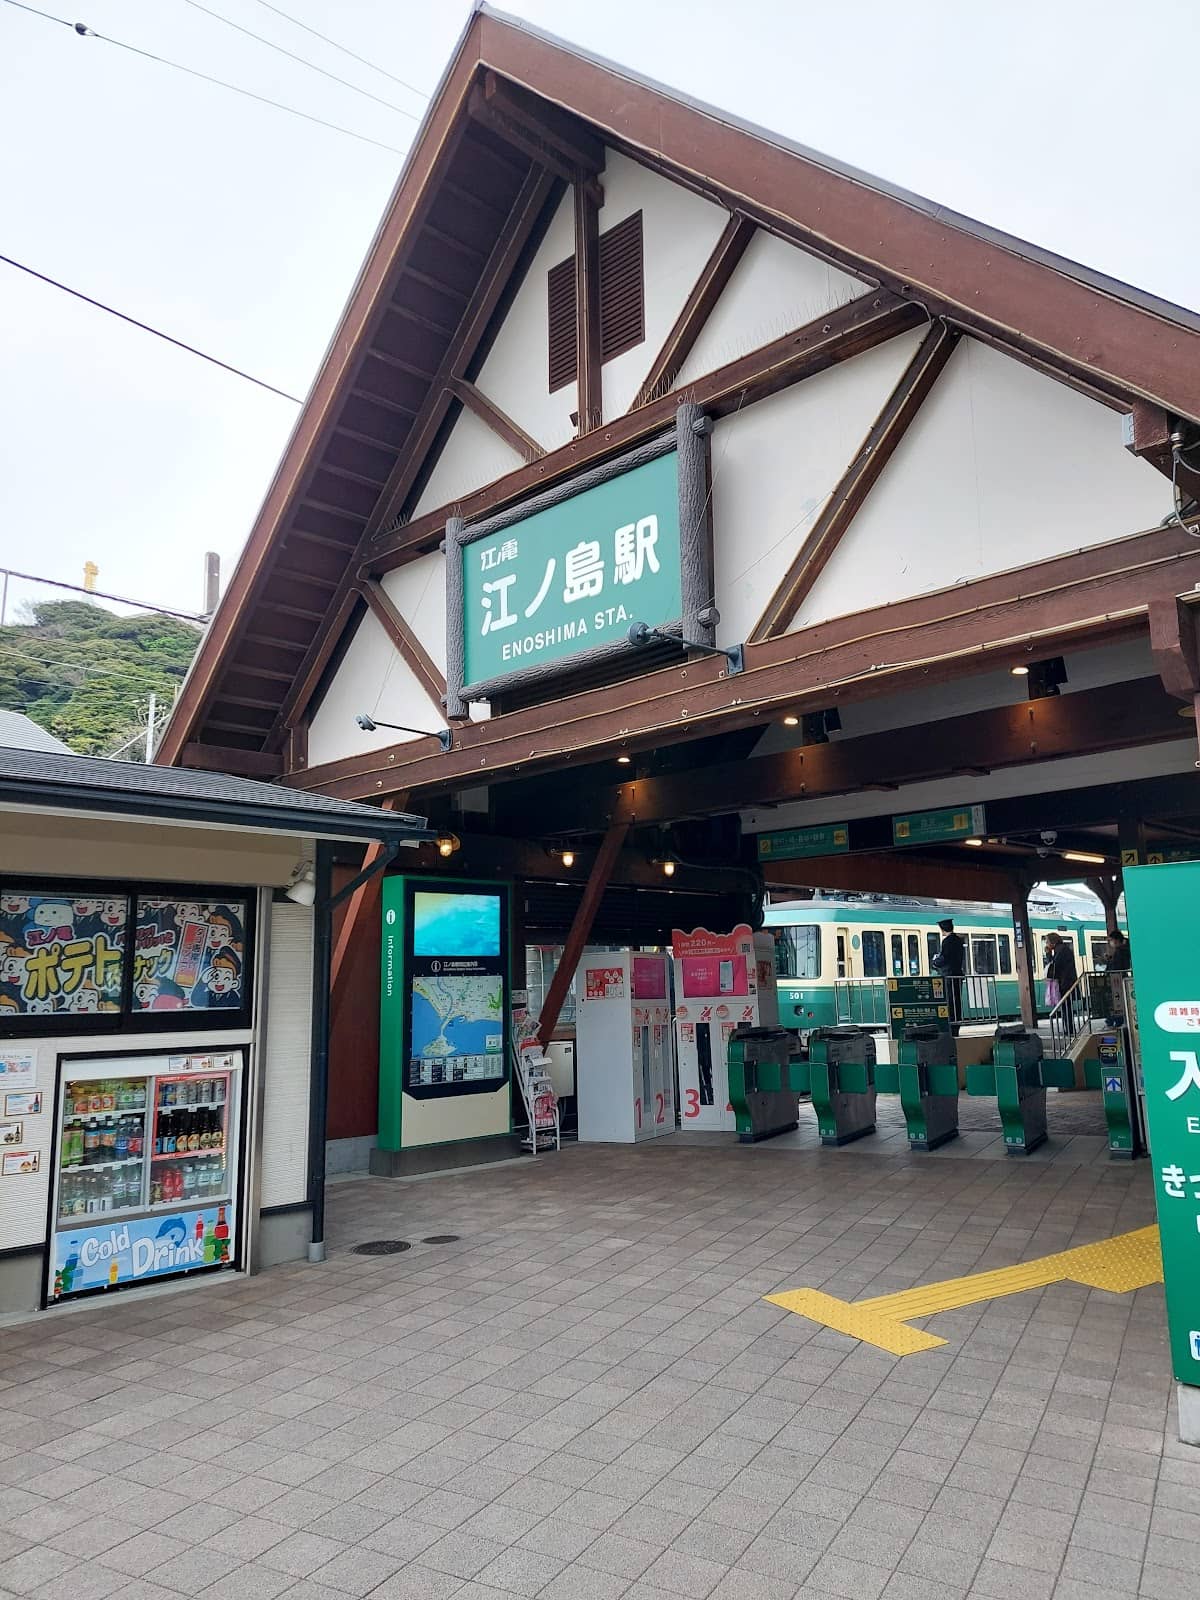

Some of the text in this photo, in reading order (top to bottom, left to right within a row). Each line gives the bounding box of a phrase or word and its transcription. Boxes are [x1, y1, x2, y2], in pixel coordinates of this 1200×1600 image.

[481, 514, 660, 637] 江ノ島駅
[502, 604, 633, 660] ENOSHIMA STA.
[789, 992, 804, 1000] 501
[635, 1098, 642, 1128] 1
[656, 1093, 665, 1124] 2
[684, 1088, 700, 1118] 3
[80, 1224, 204, 1277] Cold Drink
